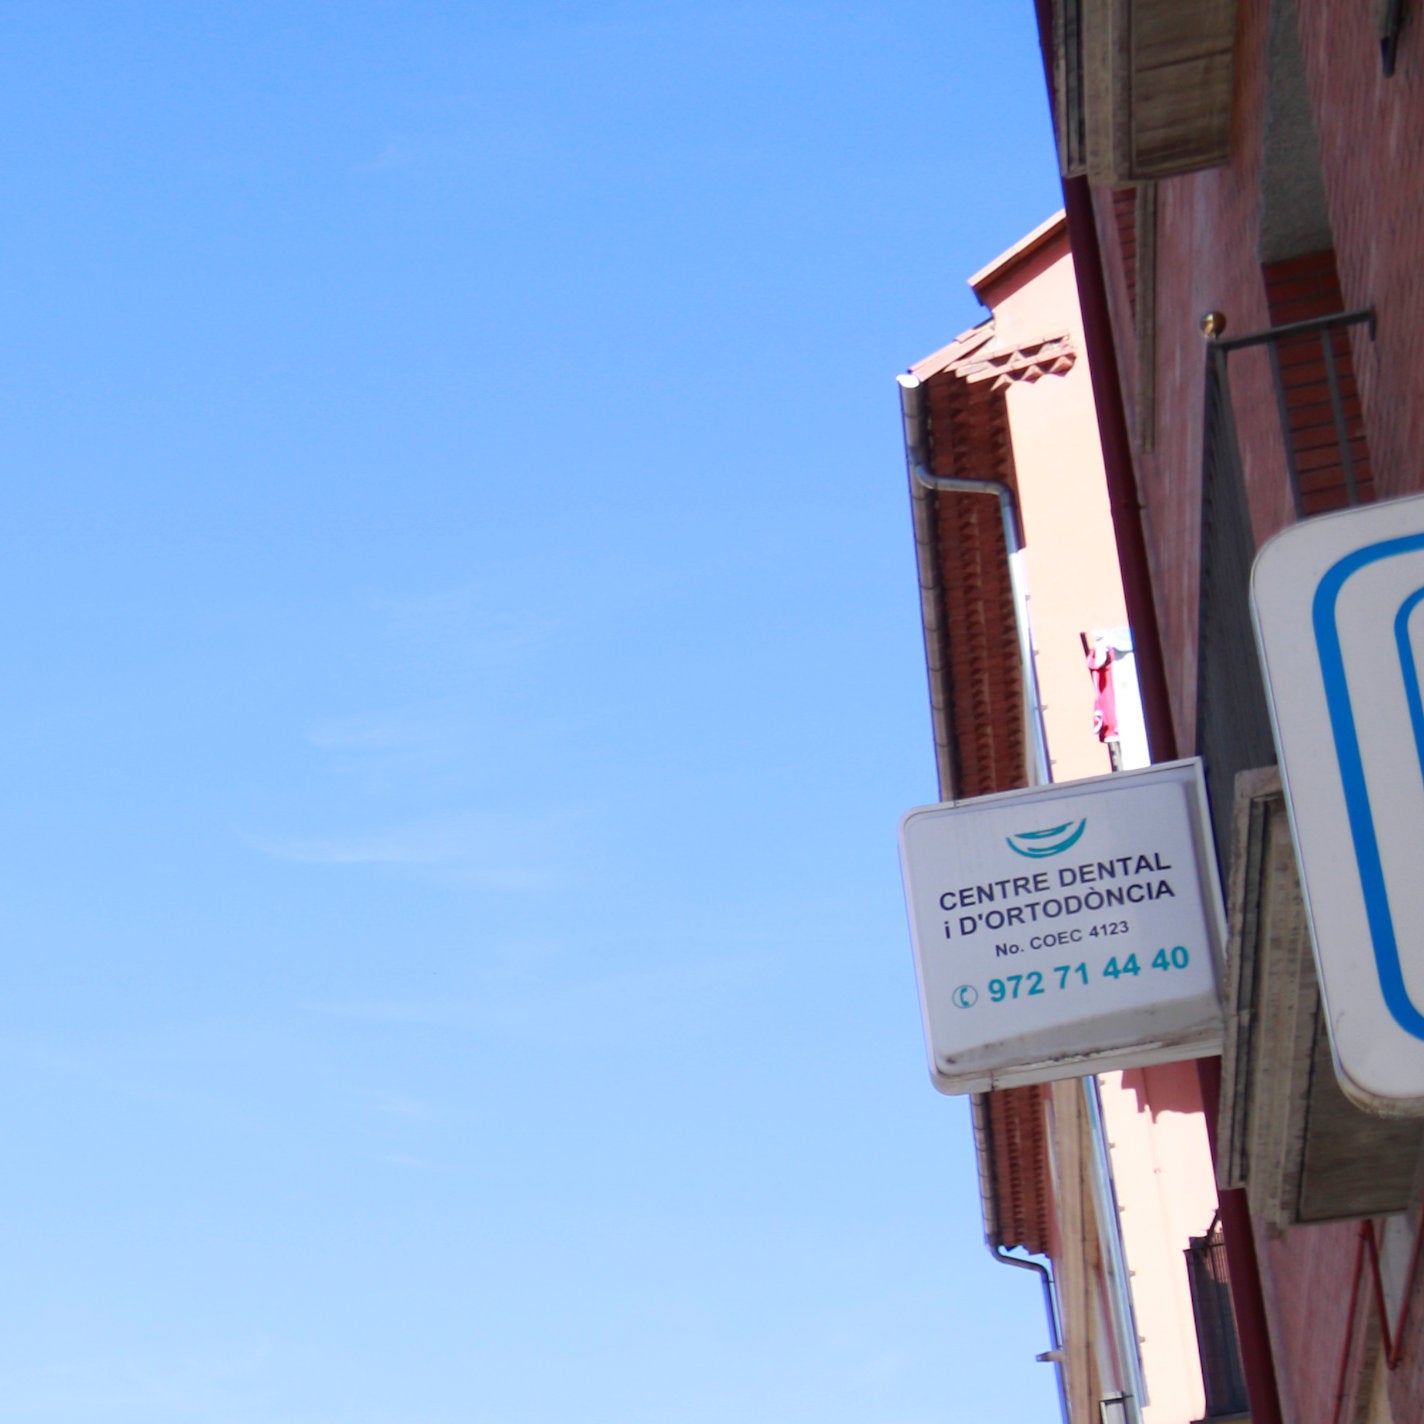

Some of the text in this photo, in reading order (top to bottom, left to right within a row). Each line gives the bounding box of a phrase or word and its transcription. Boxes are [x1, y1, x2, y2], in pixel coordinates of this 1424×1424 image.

[939, 852, 1172, 911] CENTRE DENTAL
[944, 880, 1175, 939] i D'ORTODÒNCIA
[995, 920, 1130, 957] No. COEC 4123
[988, 945, 1189, 1003] 972 71 44 40
